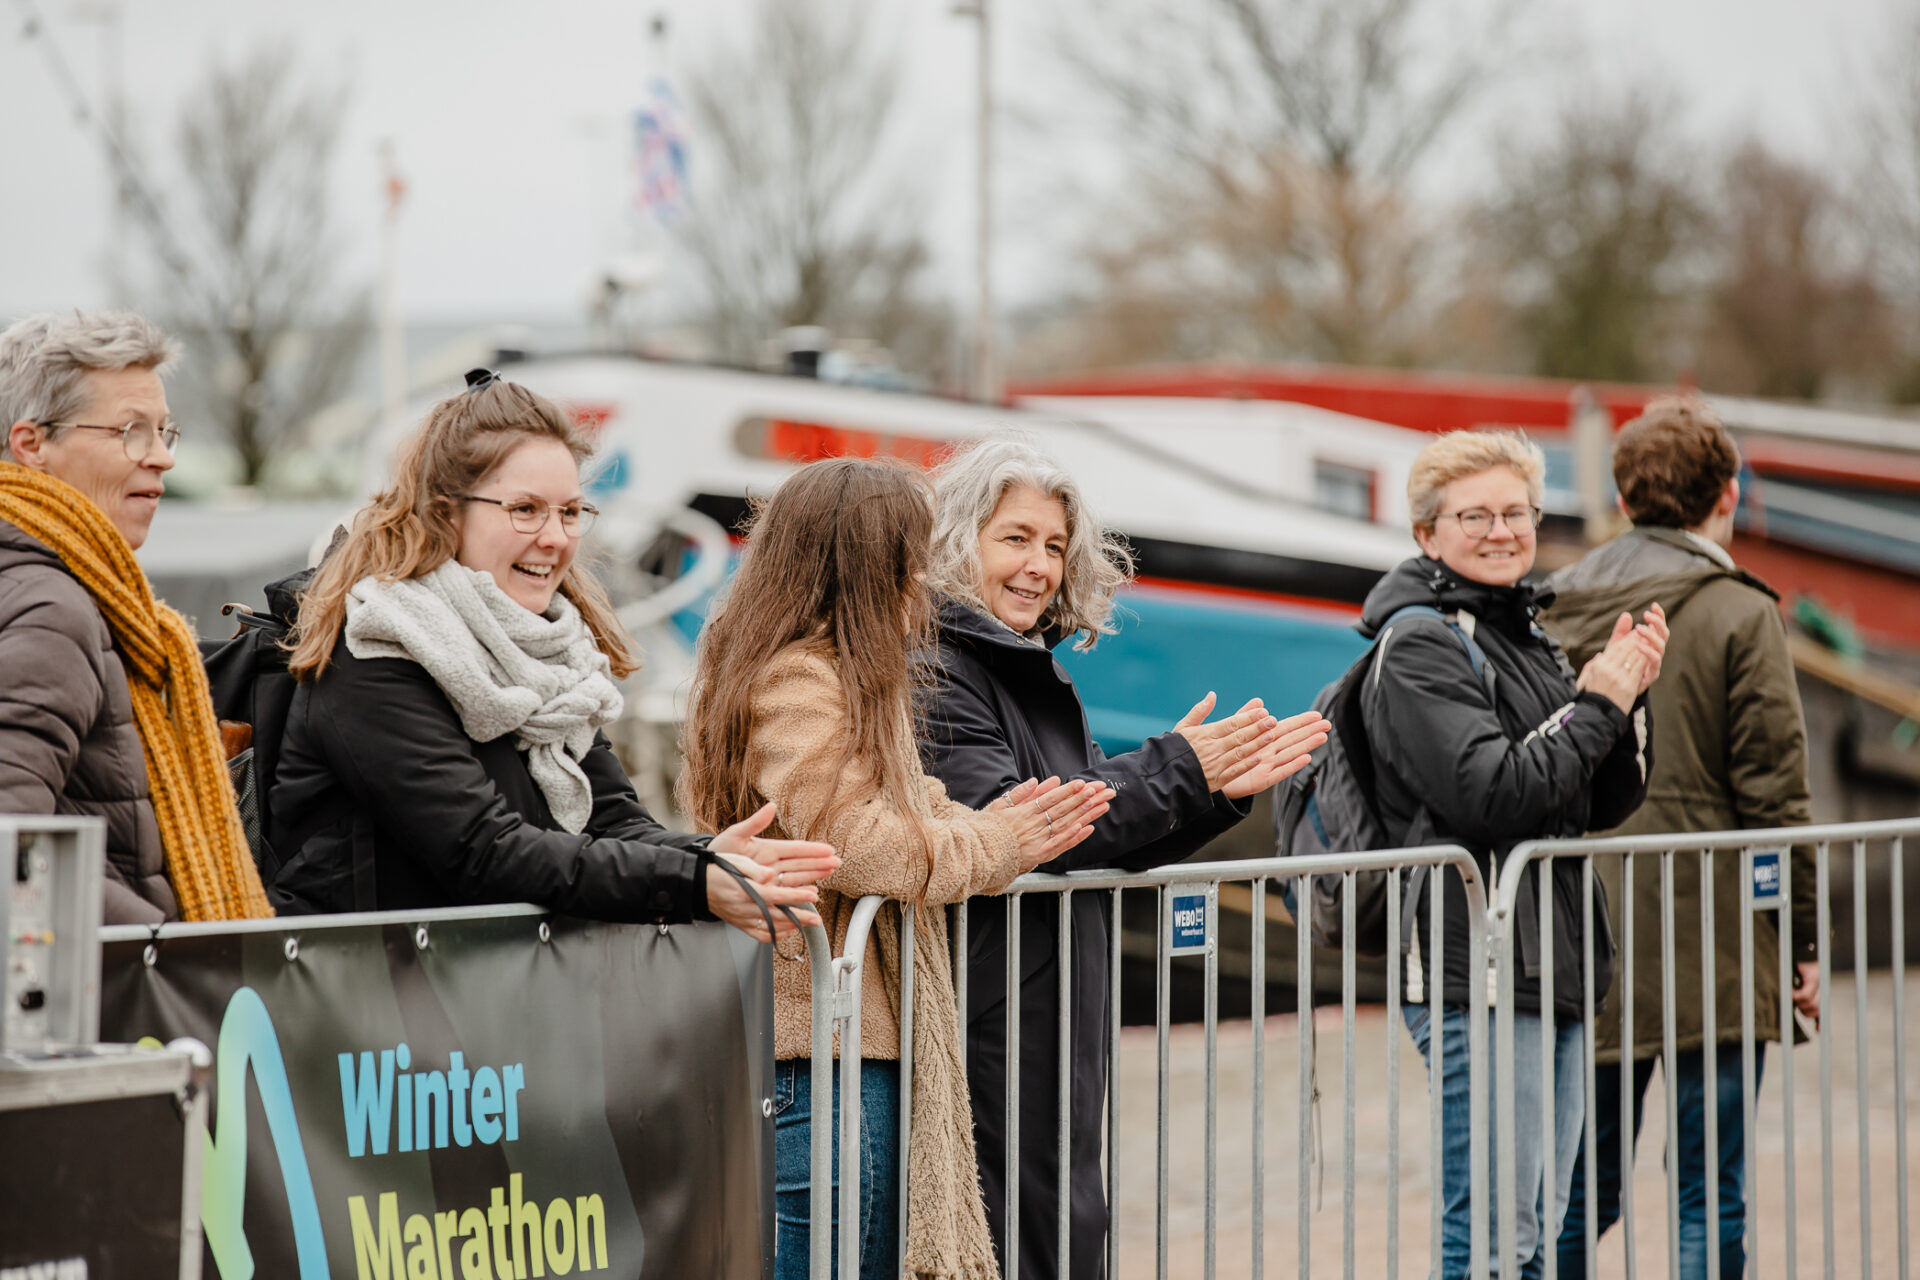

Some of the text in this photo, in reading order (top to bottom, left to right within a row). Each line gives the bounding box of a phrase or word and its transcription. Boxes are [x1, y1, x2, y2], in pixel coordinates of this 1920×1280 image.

[1174, 909, 1195, 927] WEBO
[338, 1042, 525, 1157] Winter
[348, 1172, 608, 1280] Marathon
